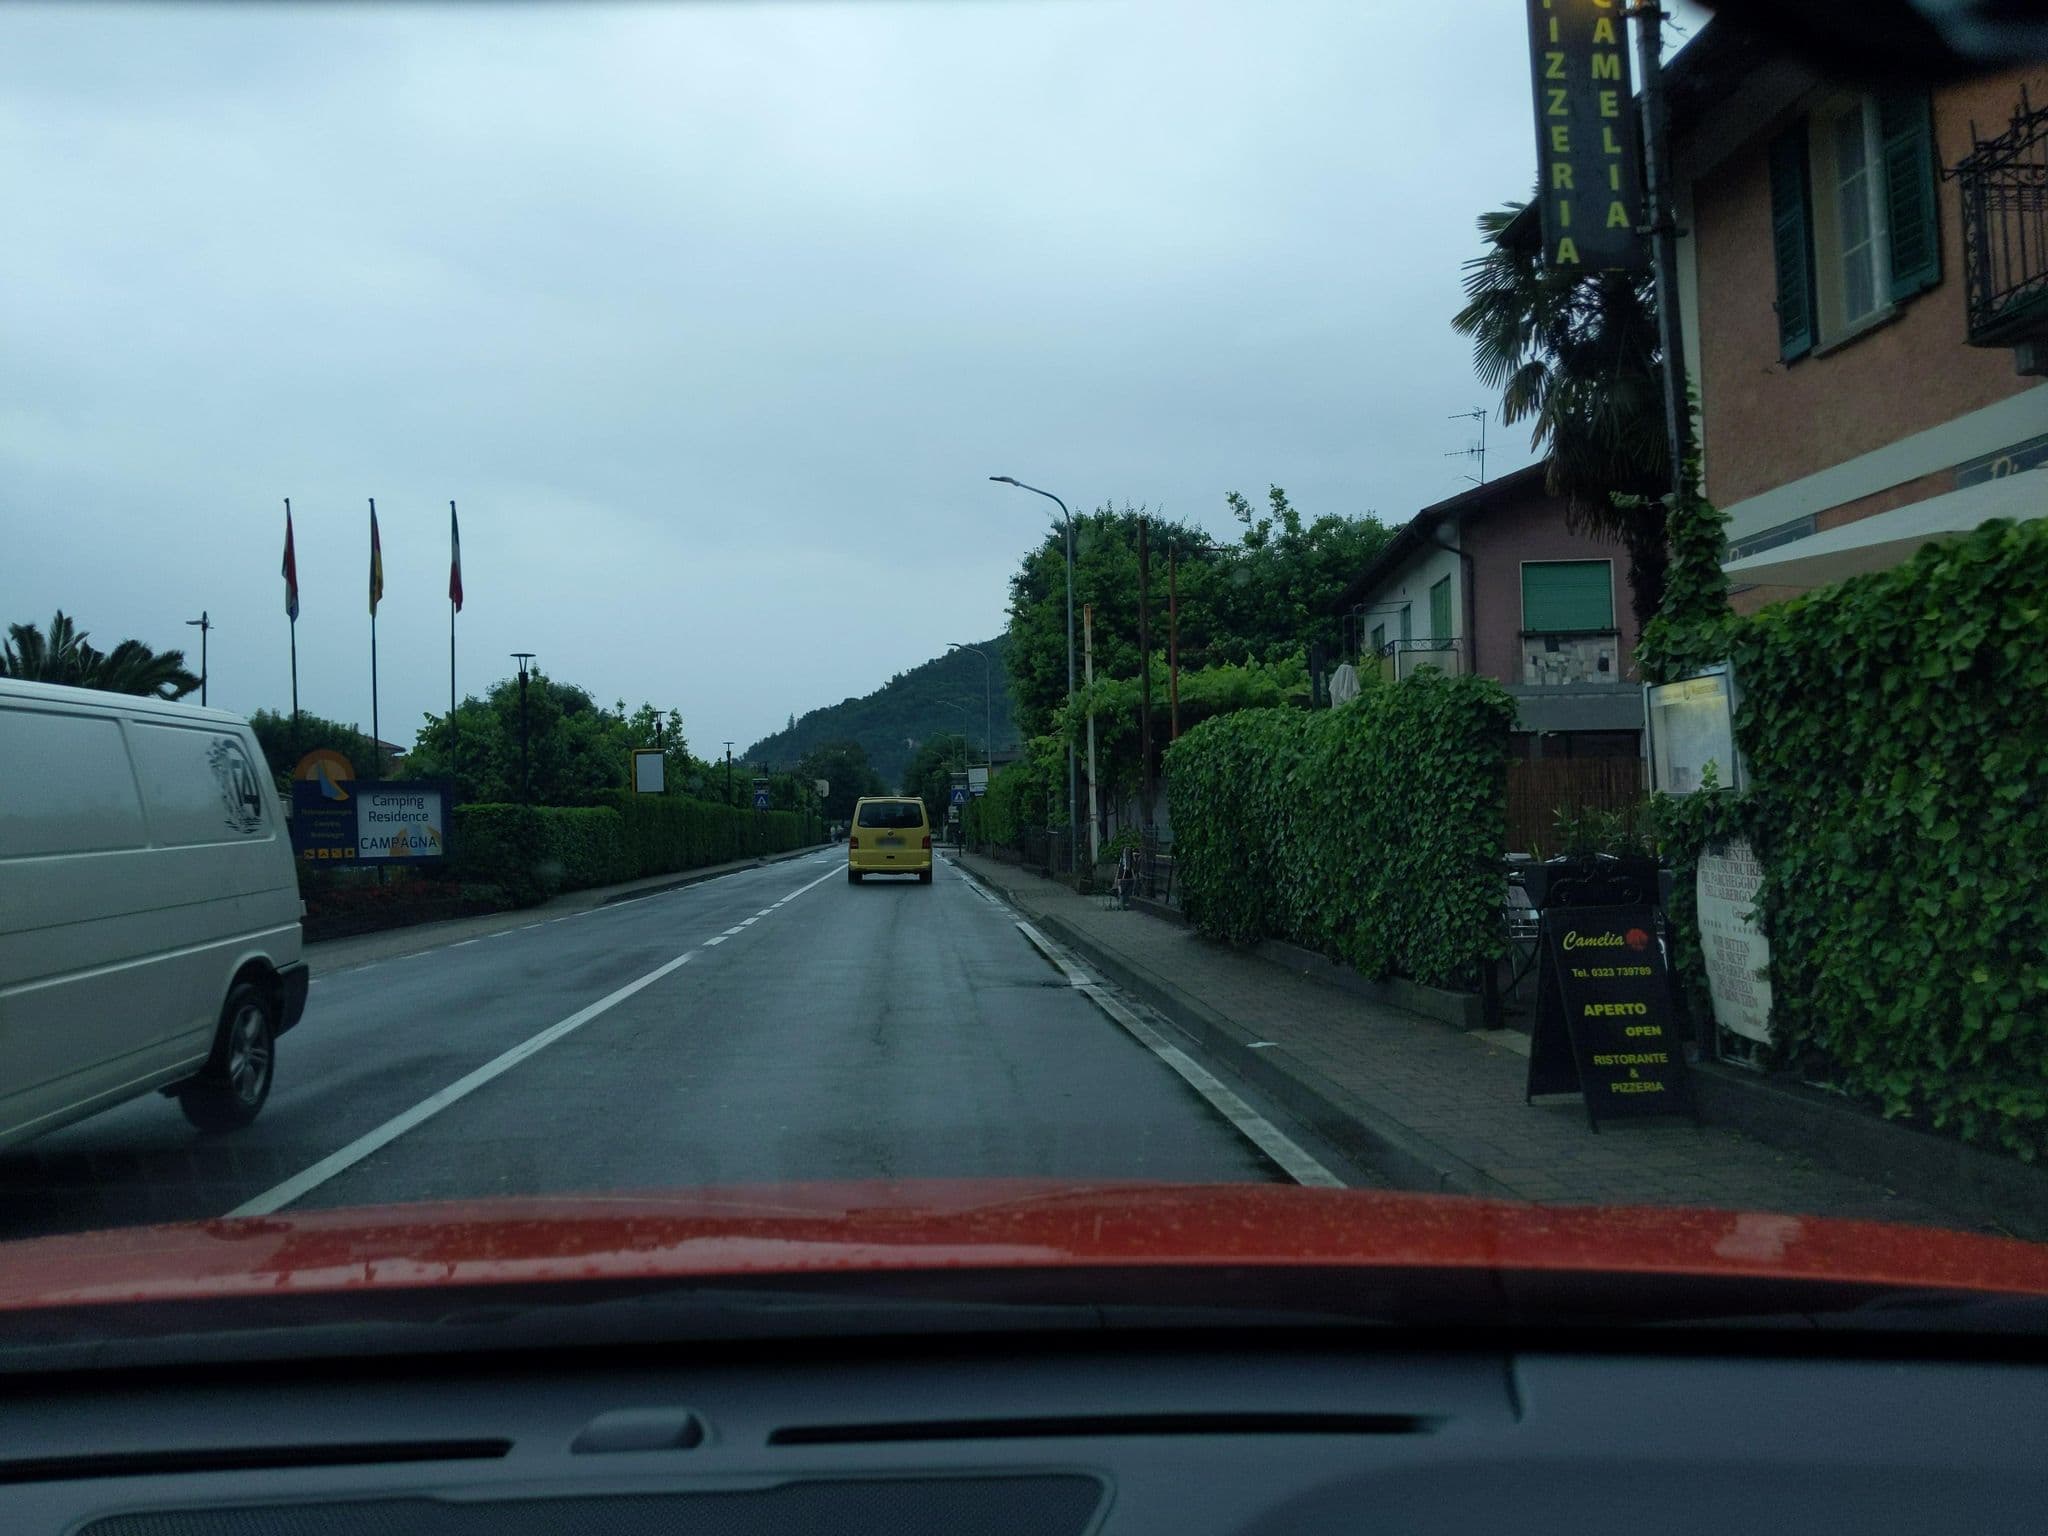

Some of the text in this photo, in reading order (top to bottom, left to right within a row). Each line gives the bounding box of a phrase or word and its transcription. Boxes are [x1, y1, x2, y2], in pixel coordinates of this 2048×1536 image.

[1543, 0, 1580, 264] IZZERIA
[372, 794, 425, 810] Camping
[368, 811, 430, 823] Residence
[360, 836, 438, 850] CAMPAGNA
[1562, 930, 1625, 951] Camelia
[1571, 967, 1588, 978] Tel.
[1583, 1002, 1648, 1016] APERTO
[1624, 1025, 1662, 1037] OPEN
[1592, 1053, 1669, 1066] RISTORANTE
[1610, 1081, 1664, 1093] PIZZERIA
